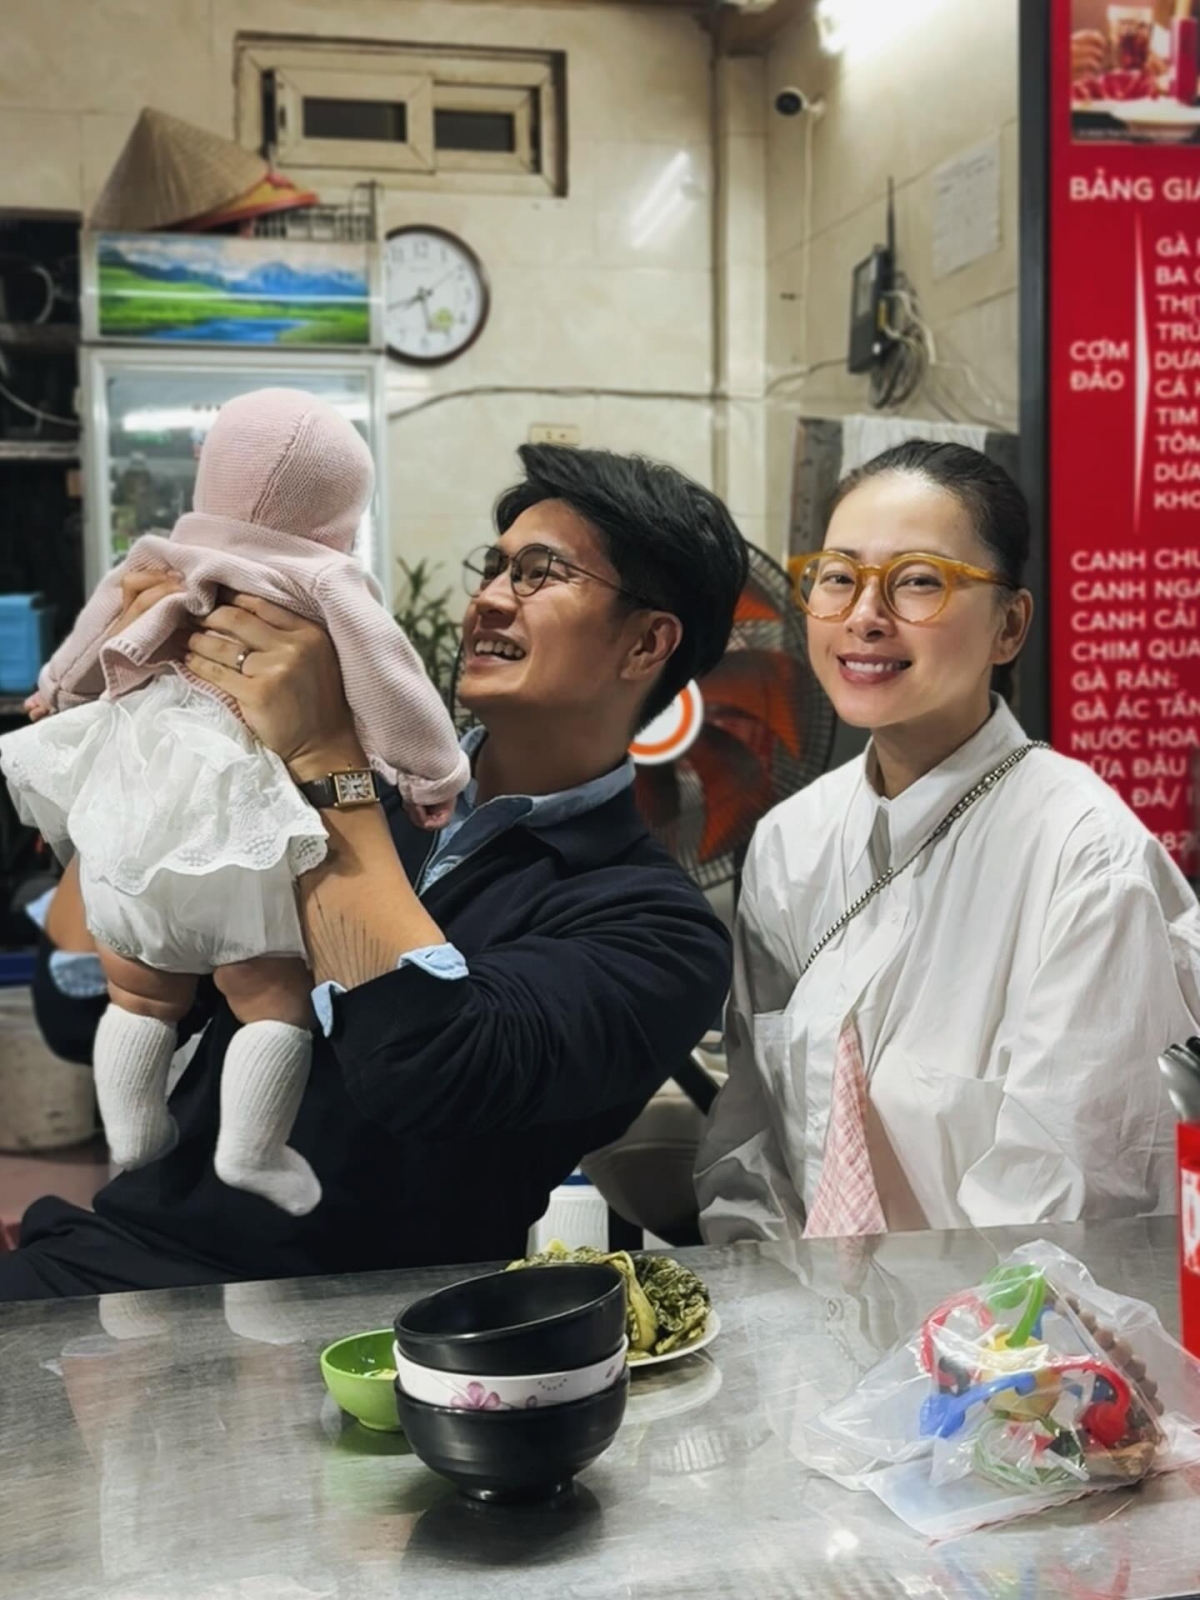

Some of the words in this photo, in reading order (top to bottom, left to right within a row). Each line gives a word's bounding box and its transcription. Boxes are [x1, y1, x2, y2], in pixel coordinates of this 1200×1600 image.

[1070, 166, 1154, 202] BẢNG
[1155, 231, 1191, 257] GÀ
[1155, 266, 1189, 286] BA
[1070, 337, 1129, 361] CƠM
[1154, 374, 1188, 399] CÁ
[1155, 407, 1198, 425] TIM
[1071, 551, 1146, 571] CANH
[1071, 580, 1146, 602] CANH
[1071, 610, 1146, 632] CANH
[1154, 600, 1197, 629] CẢI
[1071, 640, 1139, 662] CHIM
[1071, 664, 1109, 691] GÀ
[1115, 662, 1179, 690] RÁN:
[1071, 694, 1109, 721] GÀ
[1114, 693, 1150, 719] ÁC
